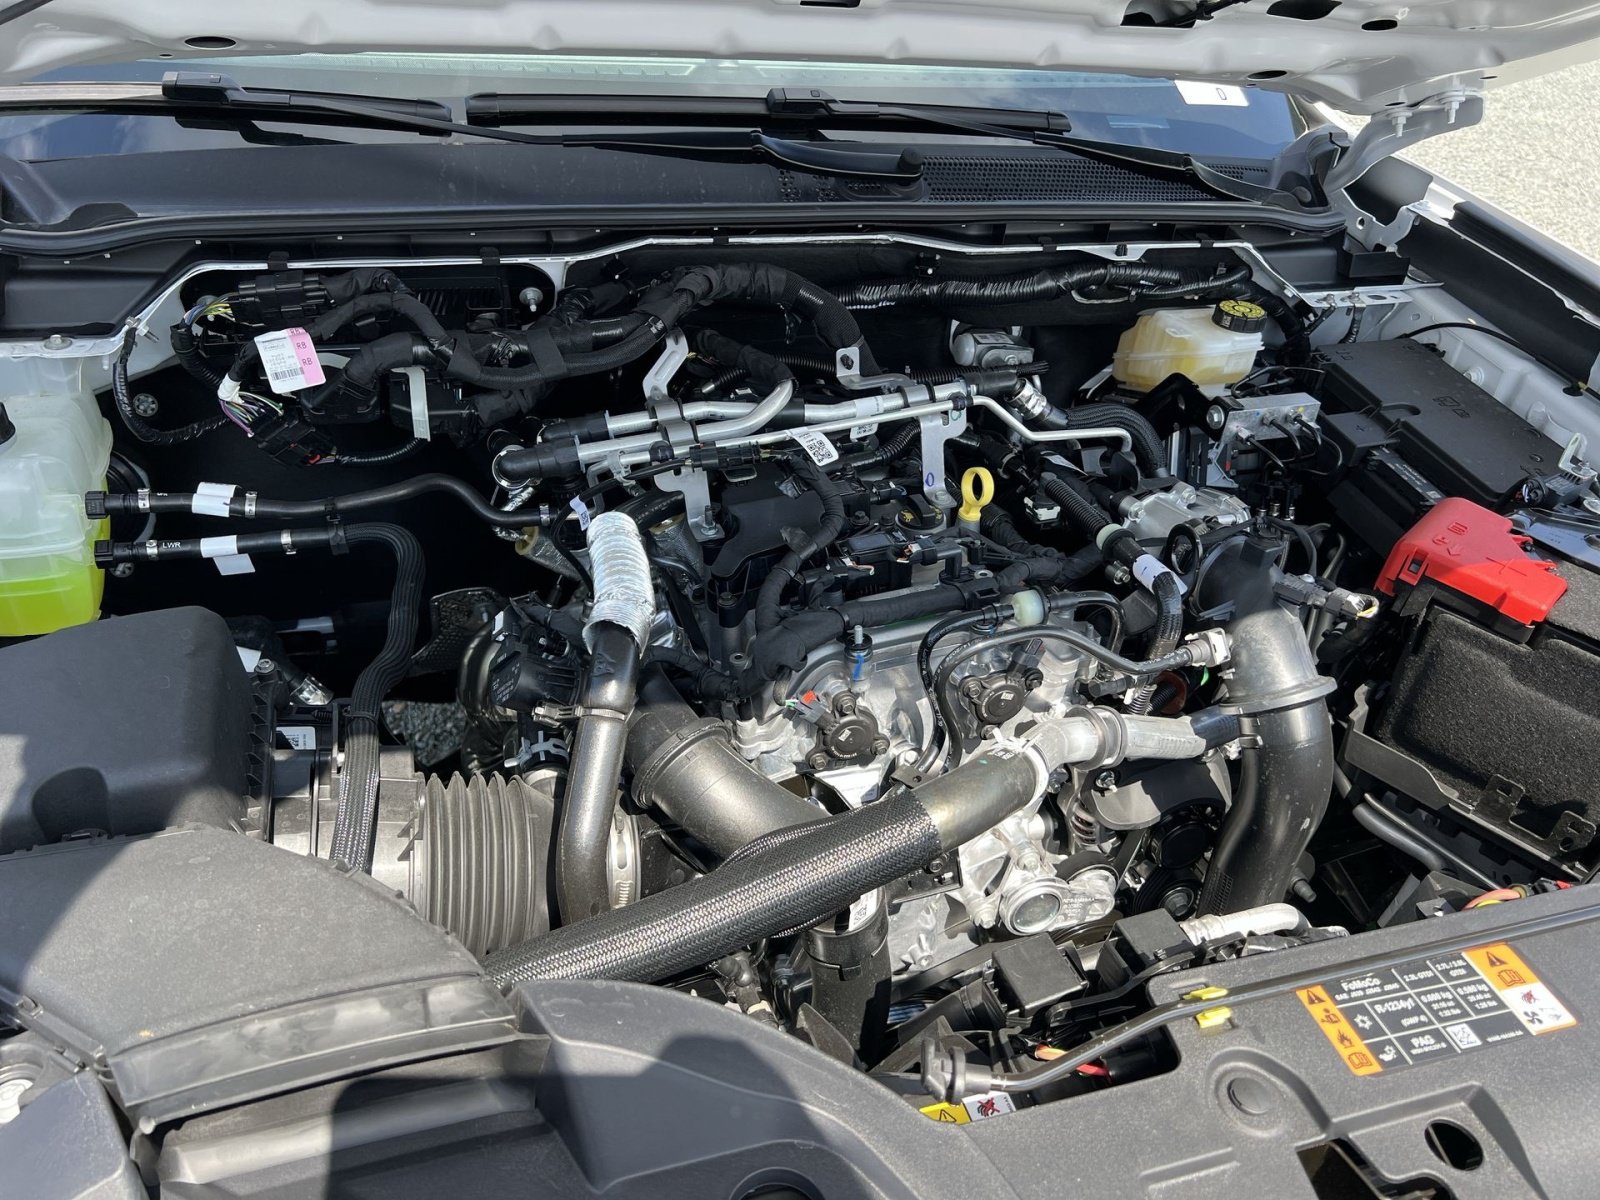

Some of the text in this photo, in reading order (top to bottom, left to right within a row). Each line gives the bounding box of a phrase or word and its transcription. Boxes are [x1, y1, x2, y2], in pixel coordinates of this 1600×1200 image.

[296, 341, 307, 349] RB
[302, 357, 313, 366] RB
[162, 541, 181, 549] LWR
[1341, 977, 1381, 991] FoMoCo
[1373, 997, 1415, 1014] R-1234yf
[1410, 1034, 1435, 1048] PAG
